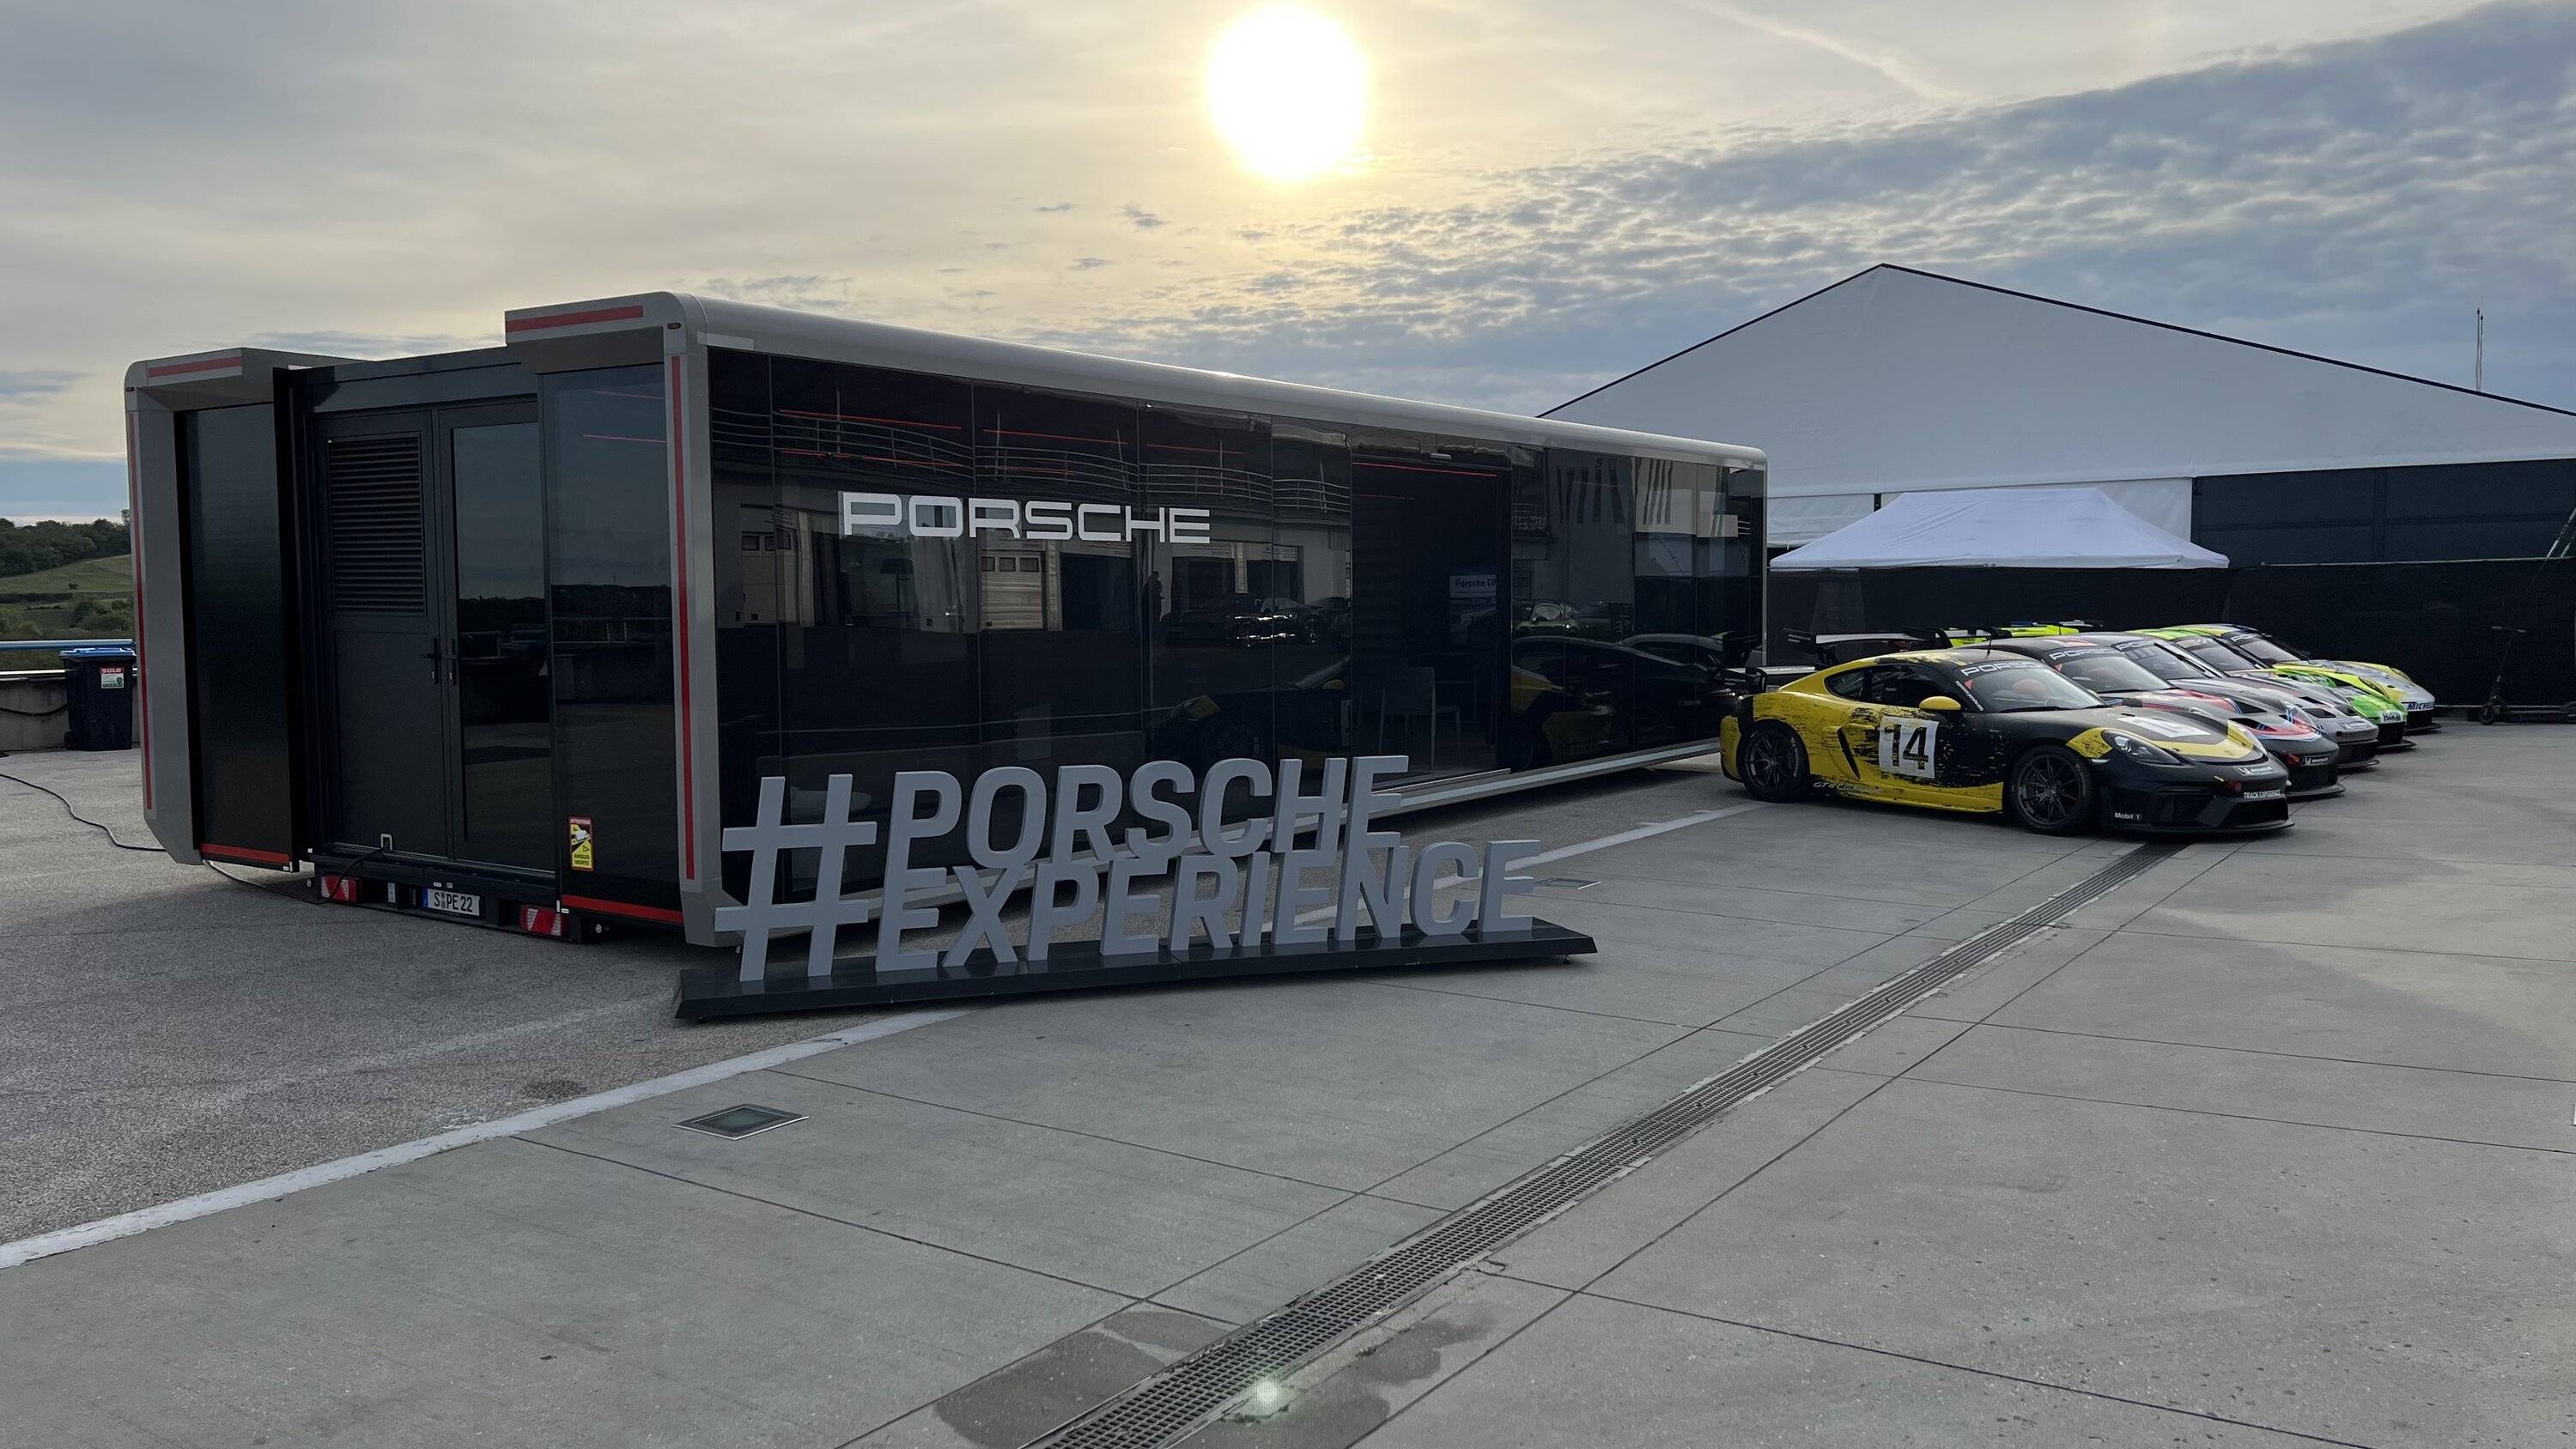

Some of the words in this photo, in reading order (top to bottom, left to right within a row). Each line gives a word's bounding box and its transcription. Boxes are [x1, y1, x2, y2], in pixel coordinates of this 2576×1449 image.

[843, 492, 1210, 543] PORSCHE
[1884, 724, 1929, 770] 14
[2114, 811, 2134, 820] Mobil
[875, 839, 1540, 972] EXPERIENCE
